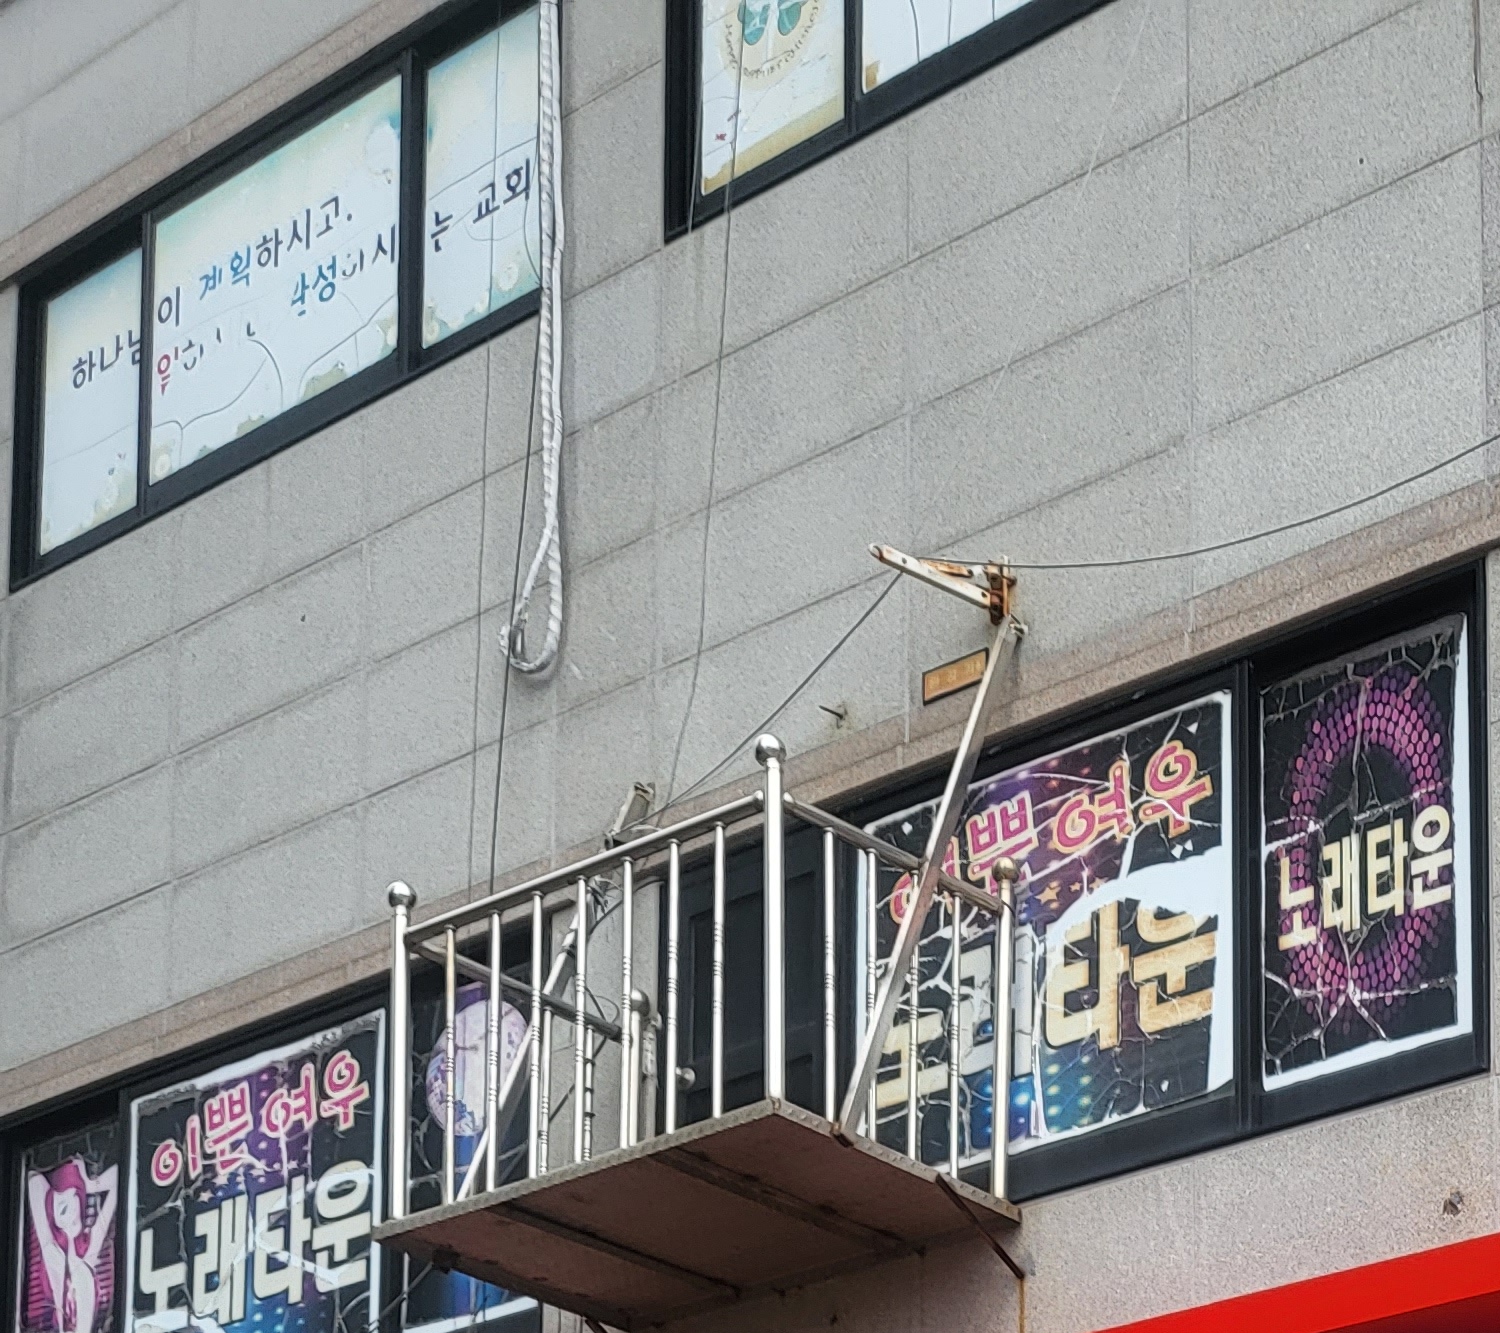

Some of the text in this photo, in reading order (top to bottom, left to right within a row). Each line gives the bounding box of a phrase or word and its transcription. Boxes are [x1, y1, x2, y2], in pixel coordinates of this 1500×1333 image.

[473, 157, 531, 225] 교회
[1276, 803, 1454, 952] 노래타운
[139, 1160, 370, 1326] 노래타운
